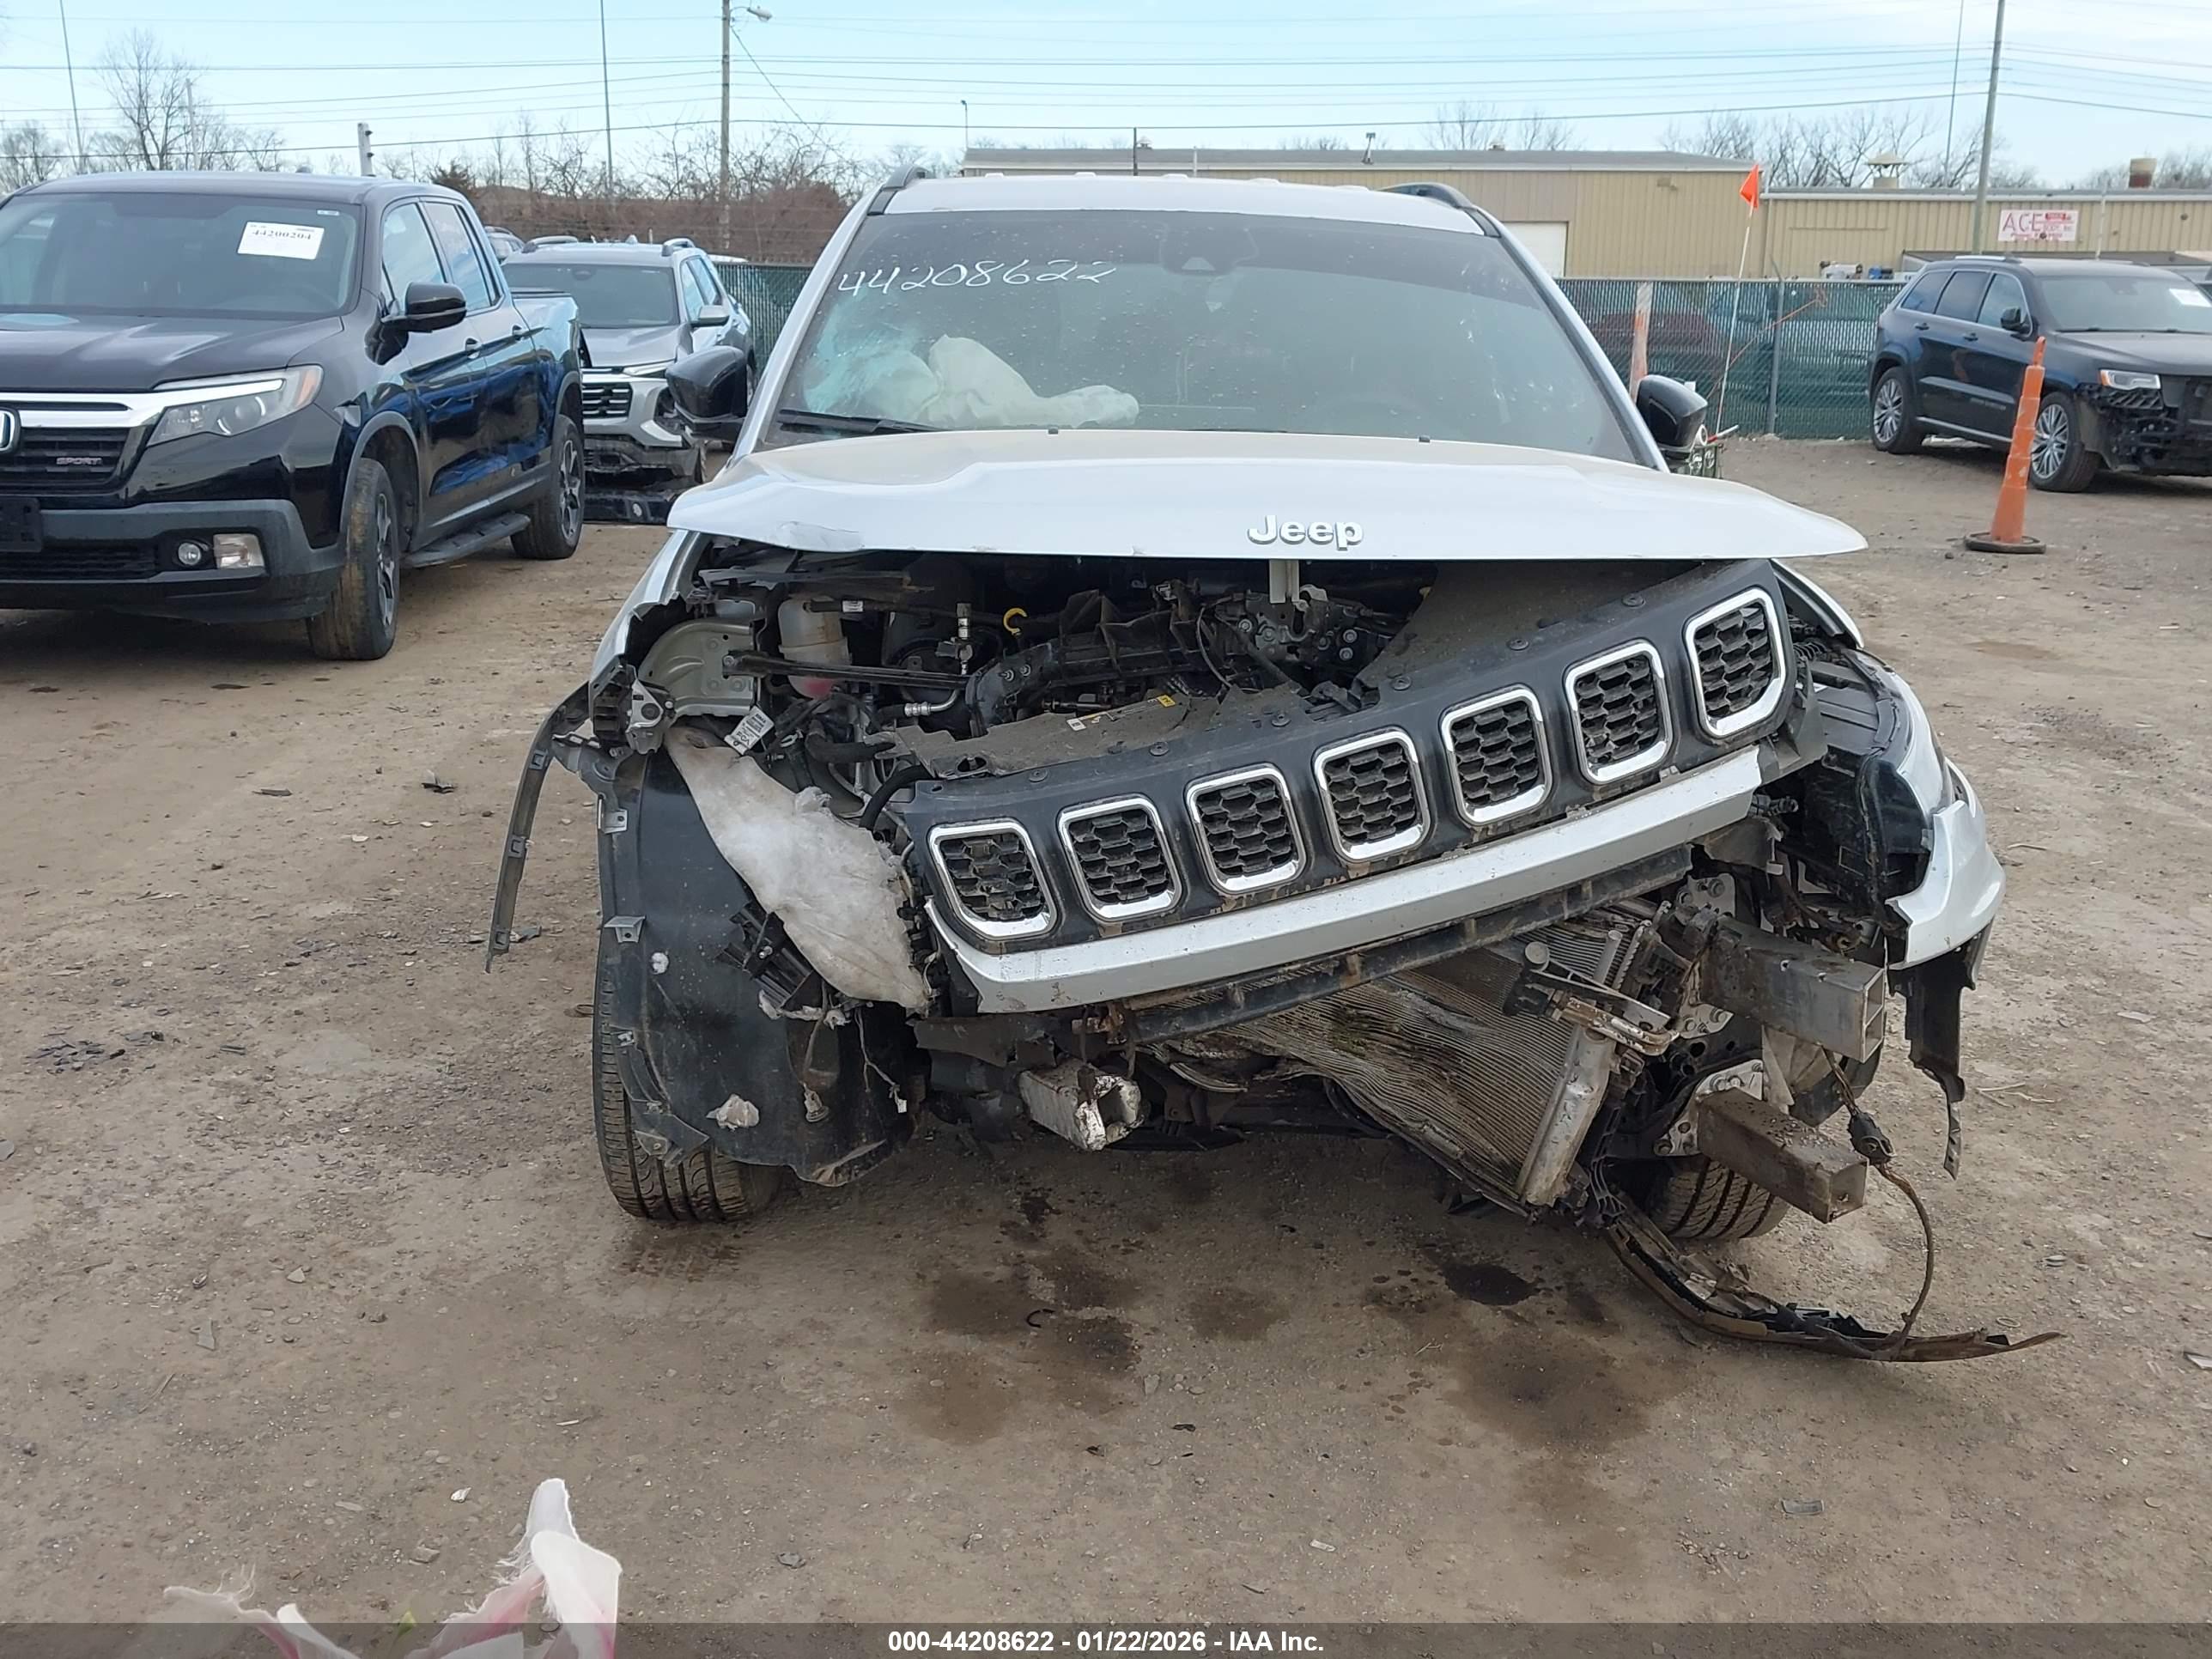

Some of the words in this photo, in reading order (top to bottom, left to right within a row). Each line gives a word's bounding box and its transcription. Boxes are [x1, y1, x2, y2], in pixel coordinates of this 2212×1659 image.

[2002, 212, 2043, 233] ACE
[838, 258, 1116, 296] 44208622
[56, 457, 102, 465] SPORT
[1247, 514, 1364, 551] Jeep
